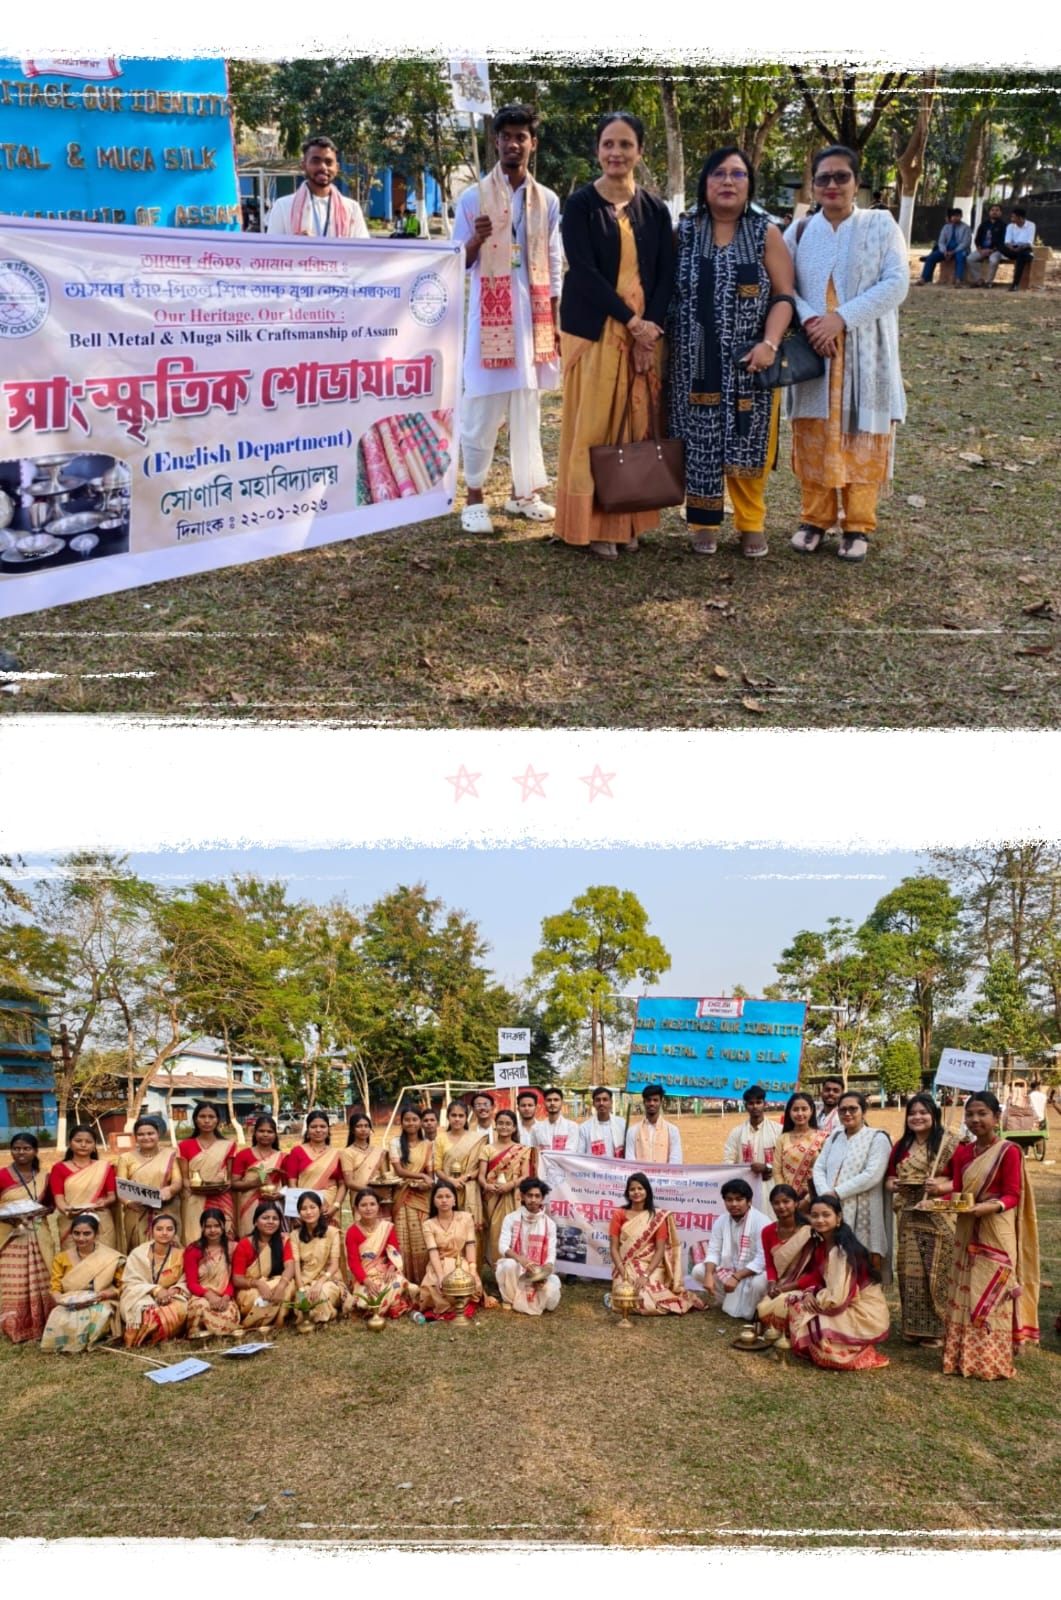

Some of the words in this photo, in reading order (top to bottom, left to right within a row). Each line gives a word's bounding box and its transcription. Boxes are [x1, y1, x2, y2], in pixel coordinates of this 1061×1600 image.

[82, 84, 123, 112] OUR
[66, 142, 84, 168] &
[164, 146, 216, 170] SILK
[135, 206, 161, 226] OF
[10, 306, 46, 335] COLLEGE
[154, 309, 185, 322] Our
[258, 308, 285, 321] Our
[289, 307, 337, 323] Identity
[69, 332, 101, 348] Bell
[107, 332, 155, 347] Metal
[160, 331, 174, 345] &
[180, 330, 222, 347] Muga
[226, 328, 253, 343] Silk
[256, 326, 348, 343] Craftsmanship
[351, 326, 363, 338] of
[364, 326, 398, 338] Assam
[3, 356, 252, 443] সাংস্কৃতিক
[143, 443, 232, 477] (English
[237, 429, 353, 461] Department)
[160, 474, 233, 515] সোণাৰি
[239, 464, 339, 500] মহাবিদ্যালয়
[176, 516, 225, 540] দিনাংক
[757, 1050, 789, 1064] SILK
